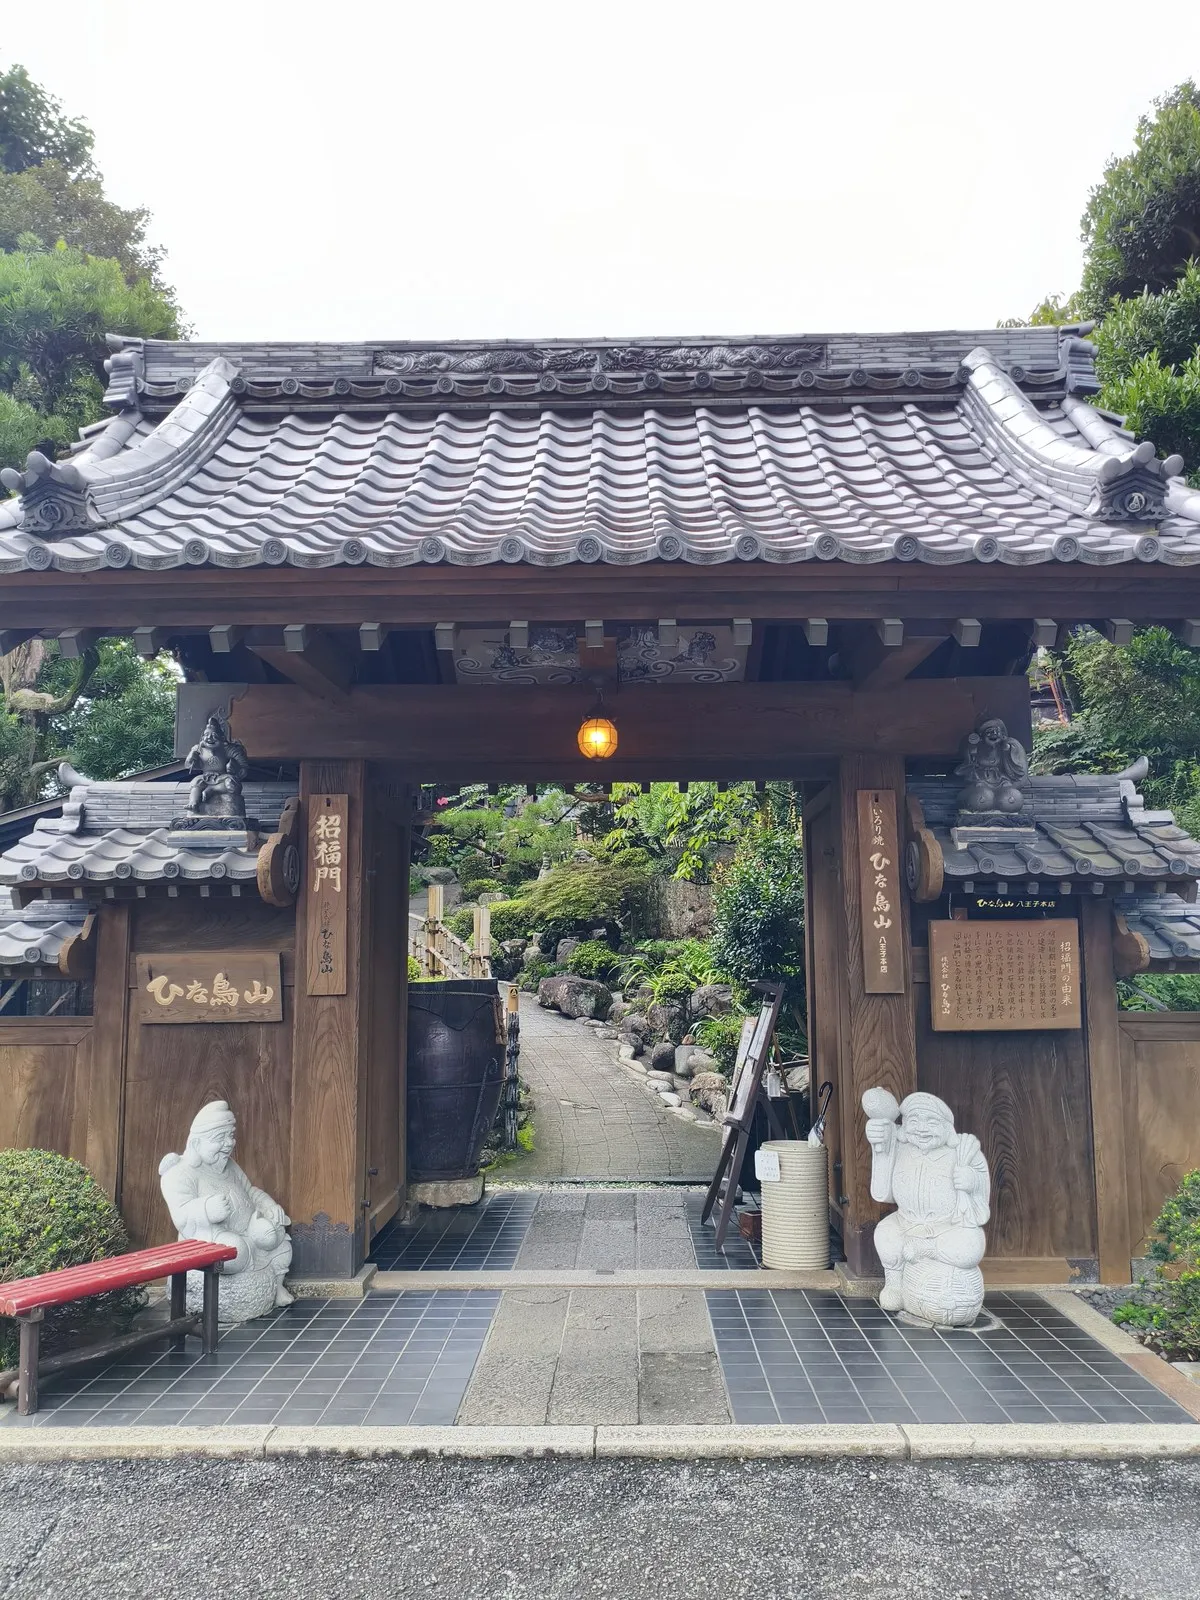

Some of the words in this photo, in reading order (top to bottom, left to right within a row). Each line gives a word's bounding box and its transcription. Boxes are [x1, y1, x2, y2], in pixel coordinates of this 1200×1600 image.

[871, 808, 885, 846] いろり焼
[313, 814, 342, 893] 招福門
[869, 852, 892, 929] ひな鳥山
[1016, 900, 1056, 908] 八王子本店
[878, 936, 888, 973] 八王子本店
[1059, 941, 1073, 1006] 招福門の由来
[146, 972, 274, 1007] ひな鳥山
